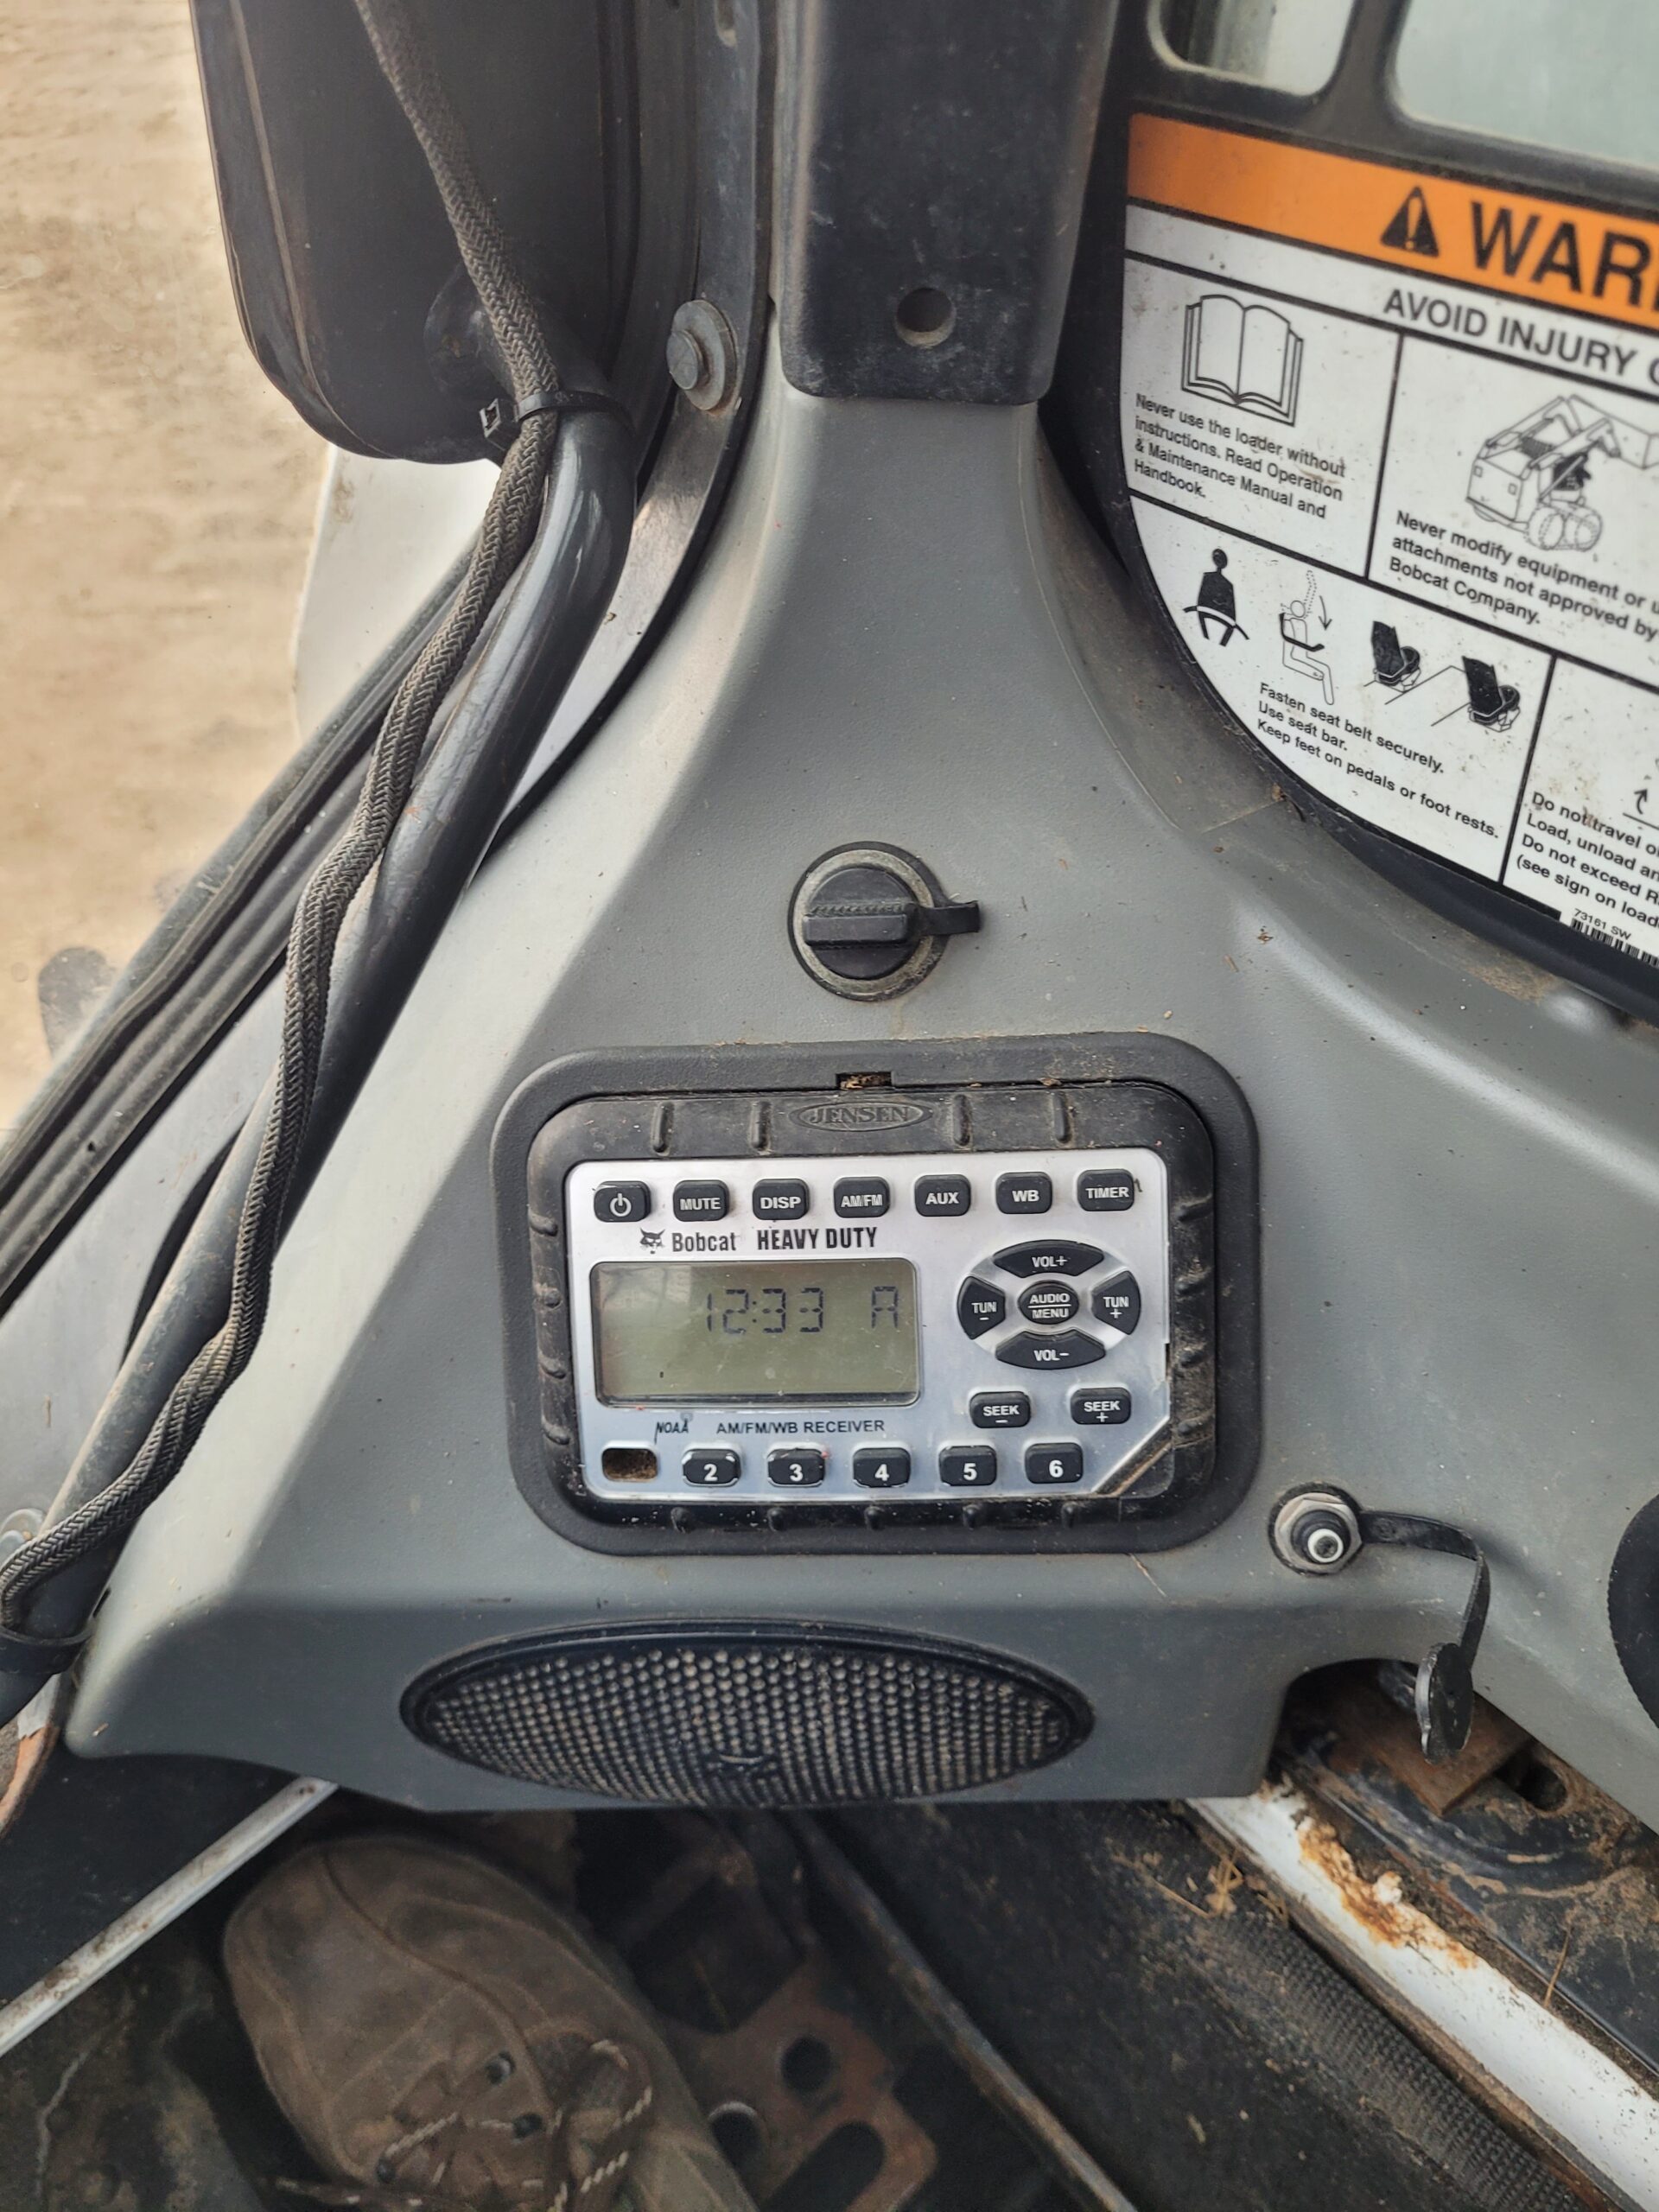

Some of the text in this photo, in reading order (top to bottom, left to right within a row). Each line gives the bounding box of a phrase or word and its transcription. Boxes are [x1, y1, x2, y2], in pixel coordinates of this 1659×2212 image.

[1471, 200, 1659, 312] WAR
[1382, 289, 1487, 337] AVOID
[1498, 316, 1638, 376] INJURY
[1135, 393, 1347, 478] Never use the loader without
[1135, 416, 1344, 501] instructions. Read Operation
[1134, 437, 1328, 519] & Maintenance Manual and
[1134, 459, 1207, 498] Handbook.
[1395, 510, 1447, 540] Never
[1451, 531, 1514, 565] modify
[1516, 555, 1620, 601] equipment
[1624, 591, 1647, 608] or
[1389, 556, 1541, 625] Bobcat Company.
[1392, 536, 1659, 643] attachments not approved by
[1259, 701, 1348, 751] Use seat bar.
[1260, 682, 1445, 774] Fasten seat belt securely.
[1257, 719, 1500, 839] Keep feet on pedals or foot rests.
[1532, 791, 1555, 812] Do
[1559, 805, 1588, 826] not
[1592, 818, 1642, 849] travel
[1527, 813, 1572, 845] Load,
[1577, 836, 1637, 872] unload
[1522, 833, 1544, 854] Do
[1548, 847, 1577, 868] not
[1580, 862, 1642, 897] exceed
[1516, 854, 1659, 929] (see sign on load
[1574, 908, 1631, 940] 73161 SW
[809, 1106, 911, 1123] JENSEN
[679, 1198, 721, 1211] MUTE
[760, 1197, 802, 1210] DISP
[841, 1194, 883, 1208] AM/FM
[925, 1192, 960, 1205] AUX
[1012, 1189, 1039, 1202] WB
[1085, 1186, 1129, 1199] TIMER
[671, 1227, 877, 1252] Bobcat HEAVY DUTY
[706, 1286, 899, 1334] 12:33 A
[972, 1302, 997, 1313] TUN
[1029, 1294, 1071, 1305] AUDIO
[1103, 1297, 1129, 1308] TUN
[1032, 1308, 1069, 1319] MENU
[983, 1405, 1020, 1416] SEEK
[1084, 1401, 1121, 1412] SEEK
[654, 1418, 690, 1445] NOAA
[716, 1420, 885, 1434] AM/FM/WB RECEIVER
[703, 1464, 718, 1481] 2
[789, 1464, 804, 1481] 3
[874, 1464, 889, 1481] 4
[963, 1463, 977, 1481] 5
[1048, 1459, 1064, 1478] 6
